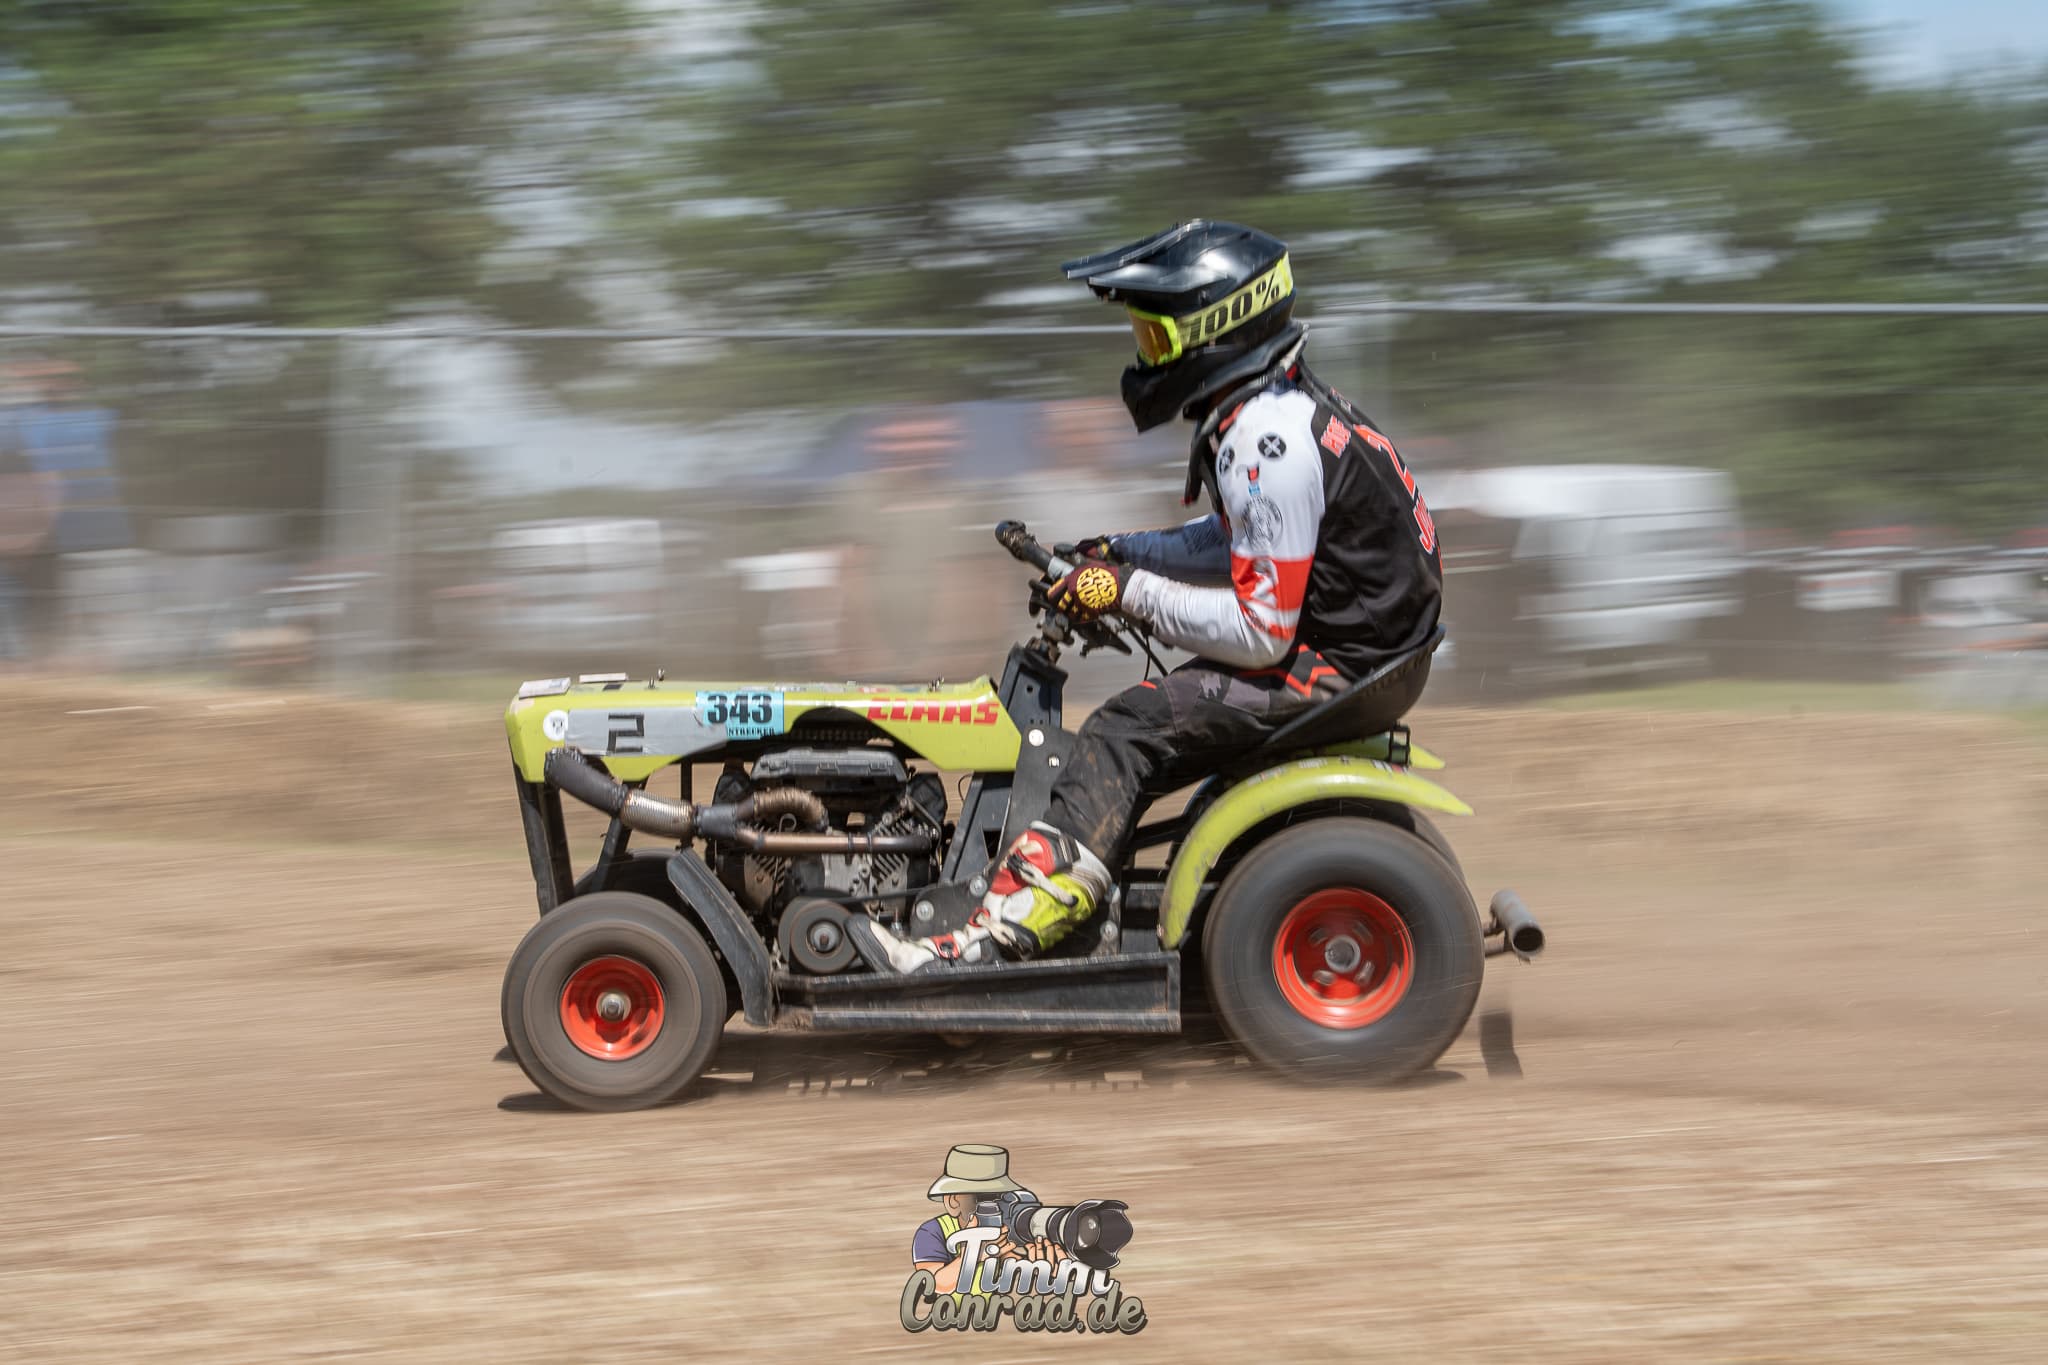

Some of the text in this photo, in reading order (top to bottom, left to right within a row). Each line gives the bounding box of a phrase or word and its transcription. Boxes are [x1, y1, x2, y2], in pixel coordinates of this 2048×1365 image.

[1187, 272, 1280, 346] 100%
[707, 693, 773, 724] 343
[867, 697, 1000, 725] CLAAS
[606, 711, 645, 754] 2
